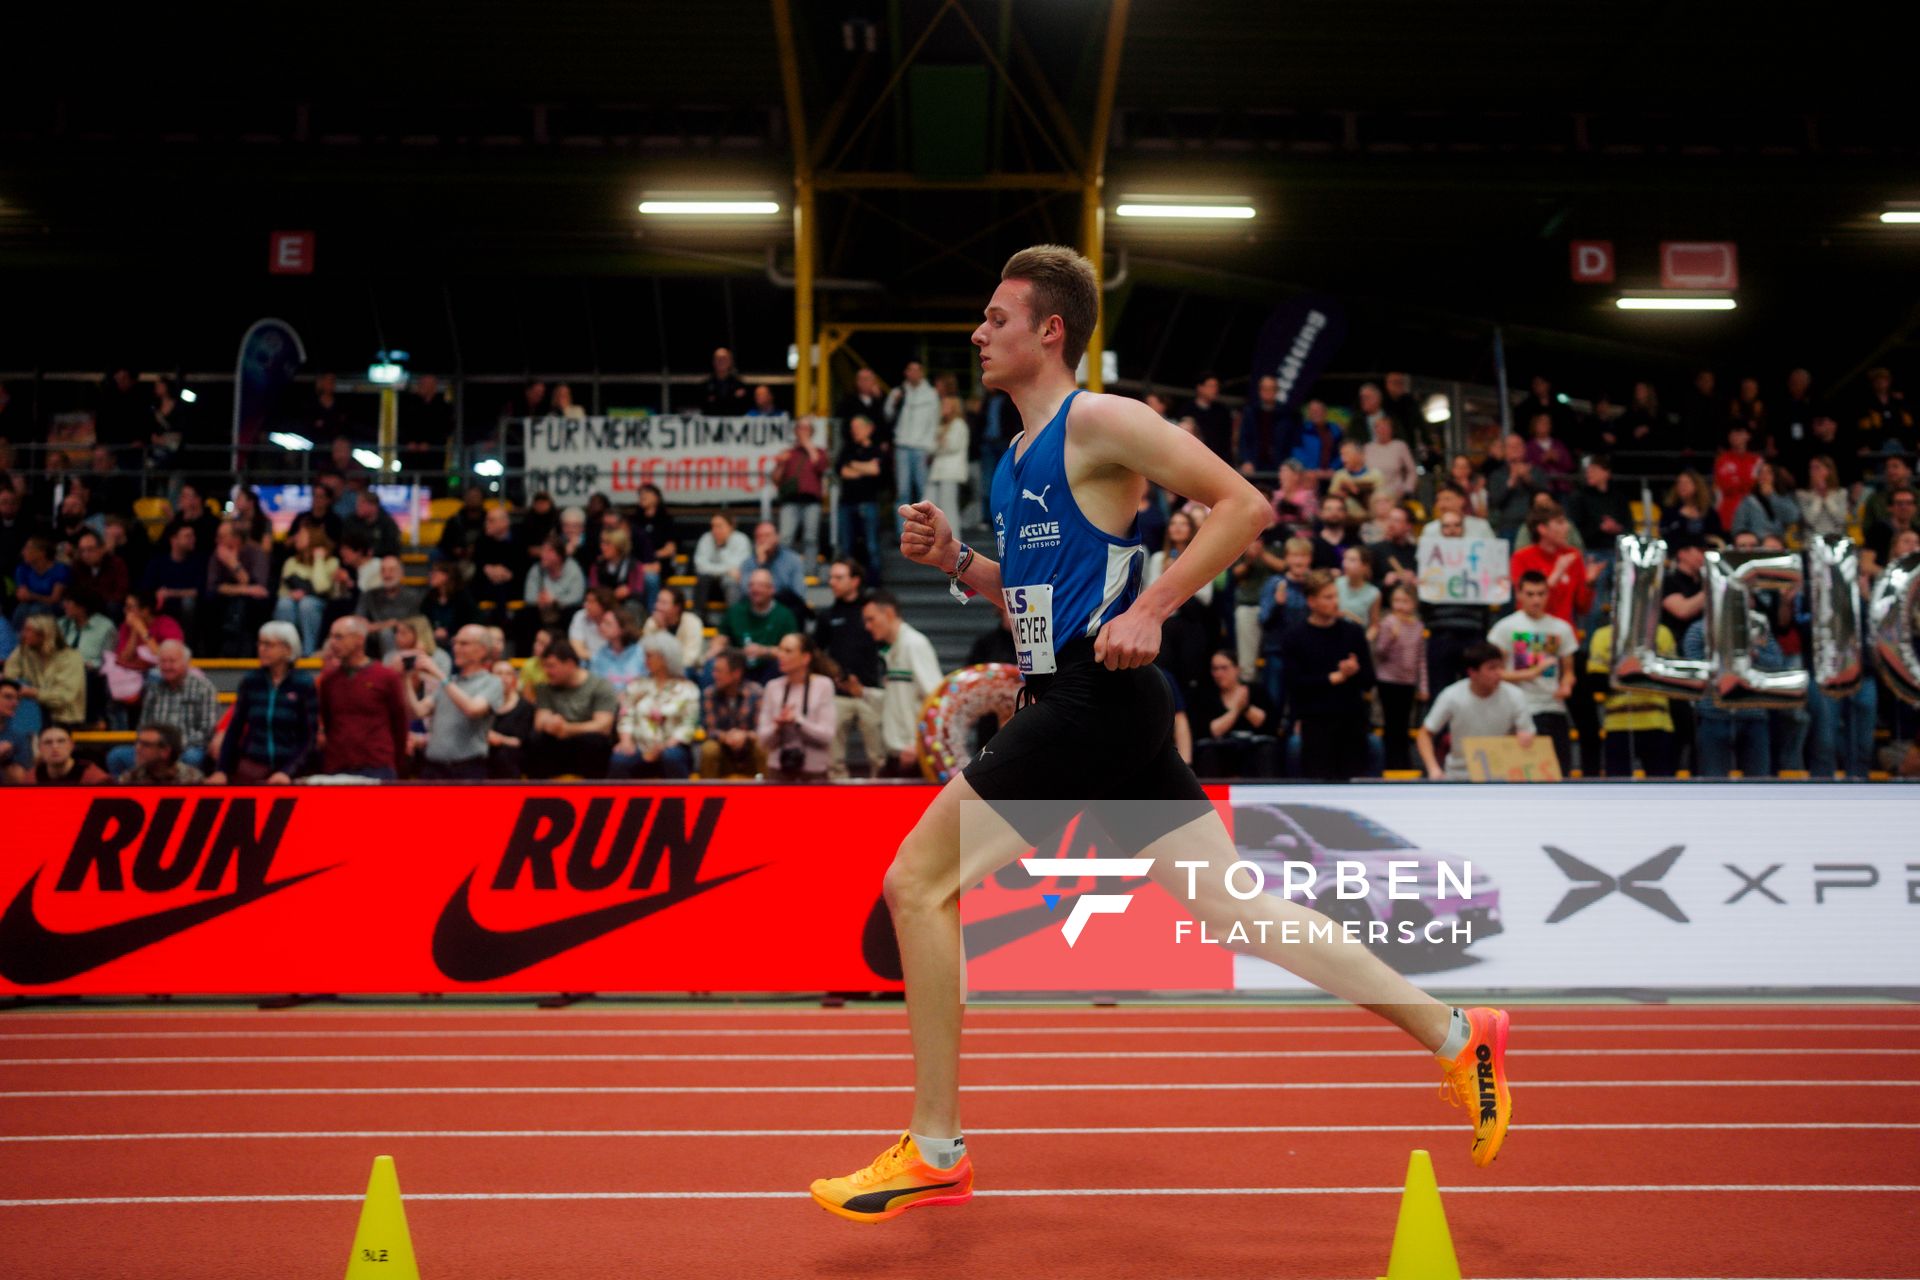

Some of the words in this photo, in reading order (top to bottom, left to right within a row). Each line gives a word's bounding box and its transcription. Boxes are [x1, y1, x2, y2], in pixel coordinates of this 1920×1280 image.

[277, 235, 304, 268] E
[1578, 246, 1608, 275] D
[1019, 540, 1061, 551] SPORTSHOP
[1427, 540, 1485, 573] Auf
[54, 797, 299, 896] RUN
[490, 796, 728, 894] RUN
[1722, 863, 1920, 905] XP
[1475, 1043, 1497, 1129] NITRO
